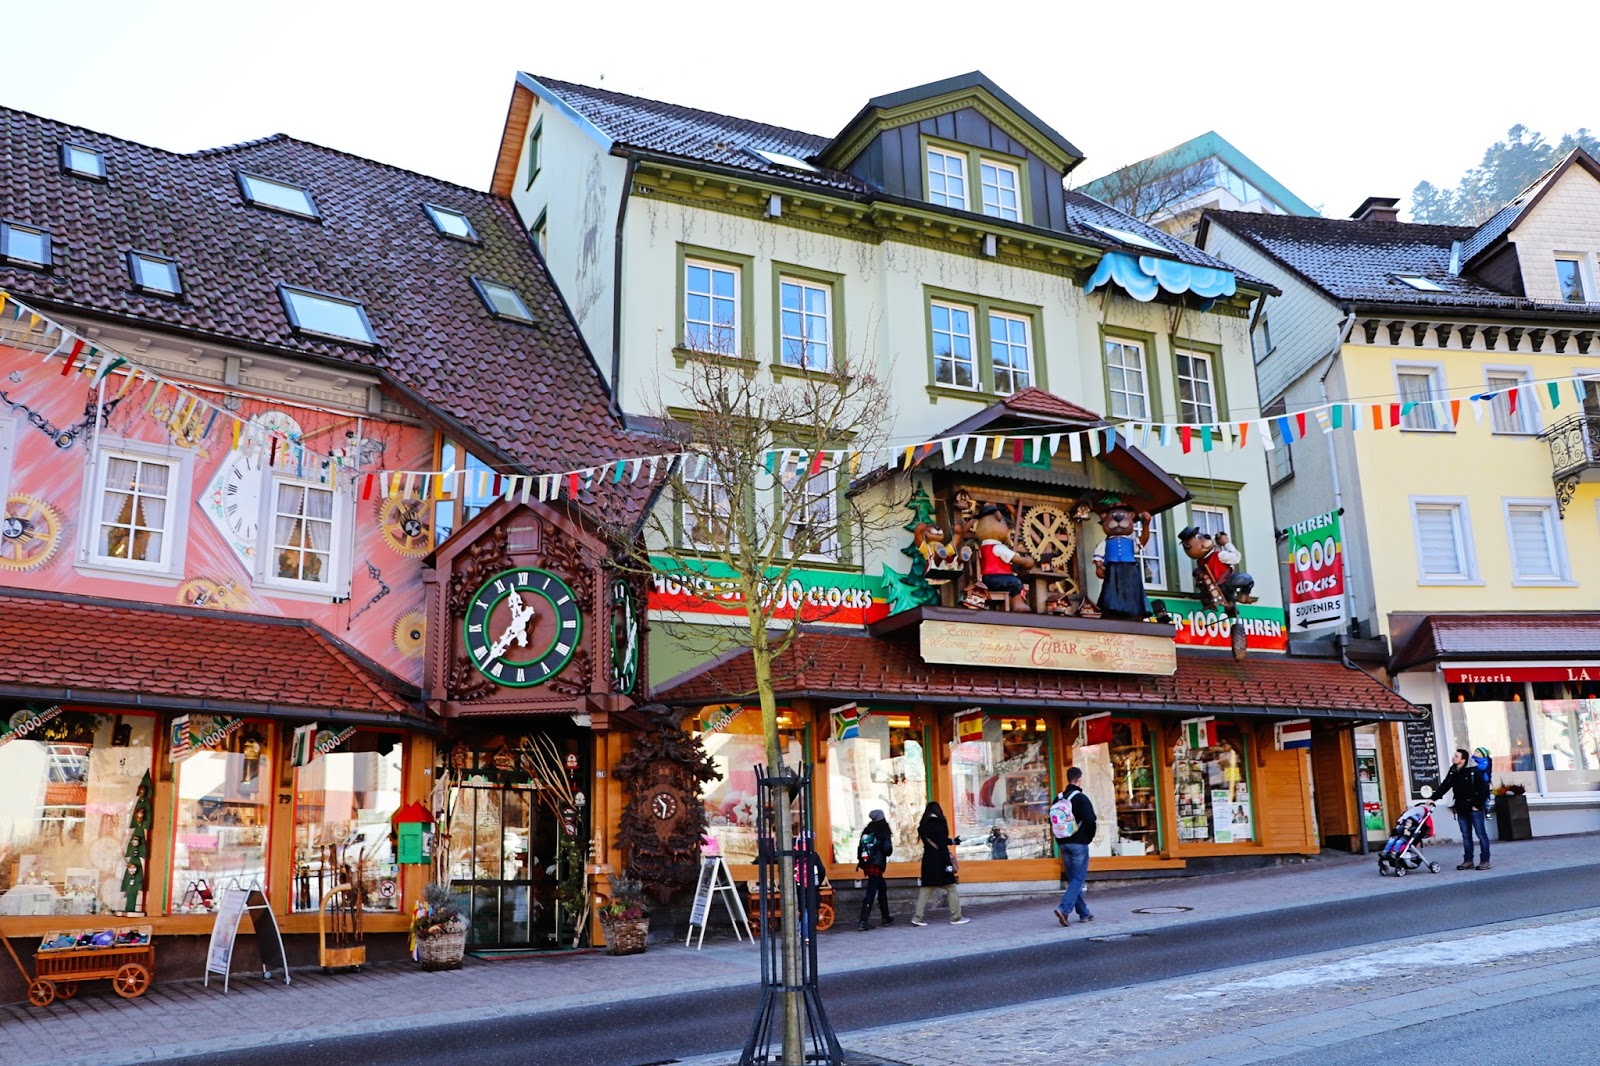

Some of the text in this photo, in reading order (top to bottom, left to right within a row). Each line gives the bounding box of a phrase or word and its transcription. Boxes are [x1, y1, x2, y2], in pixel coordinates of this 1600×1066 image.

[756, 577, 804, 610] 000
[807, 585, 872, 609] CLOCKS
[1295, 574, 1337, 595] CLOCKS
[1296, 600, 1341, 617] SOUVENIRS
[1188, 611, 1231, 639] 1000
[1232, 616, 1282, 638] HREN
[1460, 673, 1512, 683] Pizzeria
[1566, 667, 1592, 681] LA
[14, 715, 43, 738] 1000
[713, 714, 732, 733] 1000
[202, 728, 227, 748] 1000
[319, 735, 341, 755] 1000
[278, 793, 292, 804] 79
